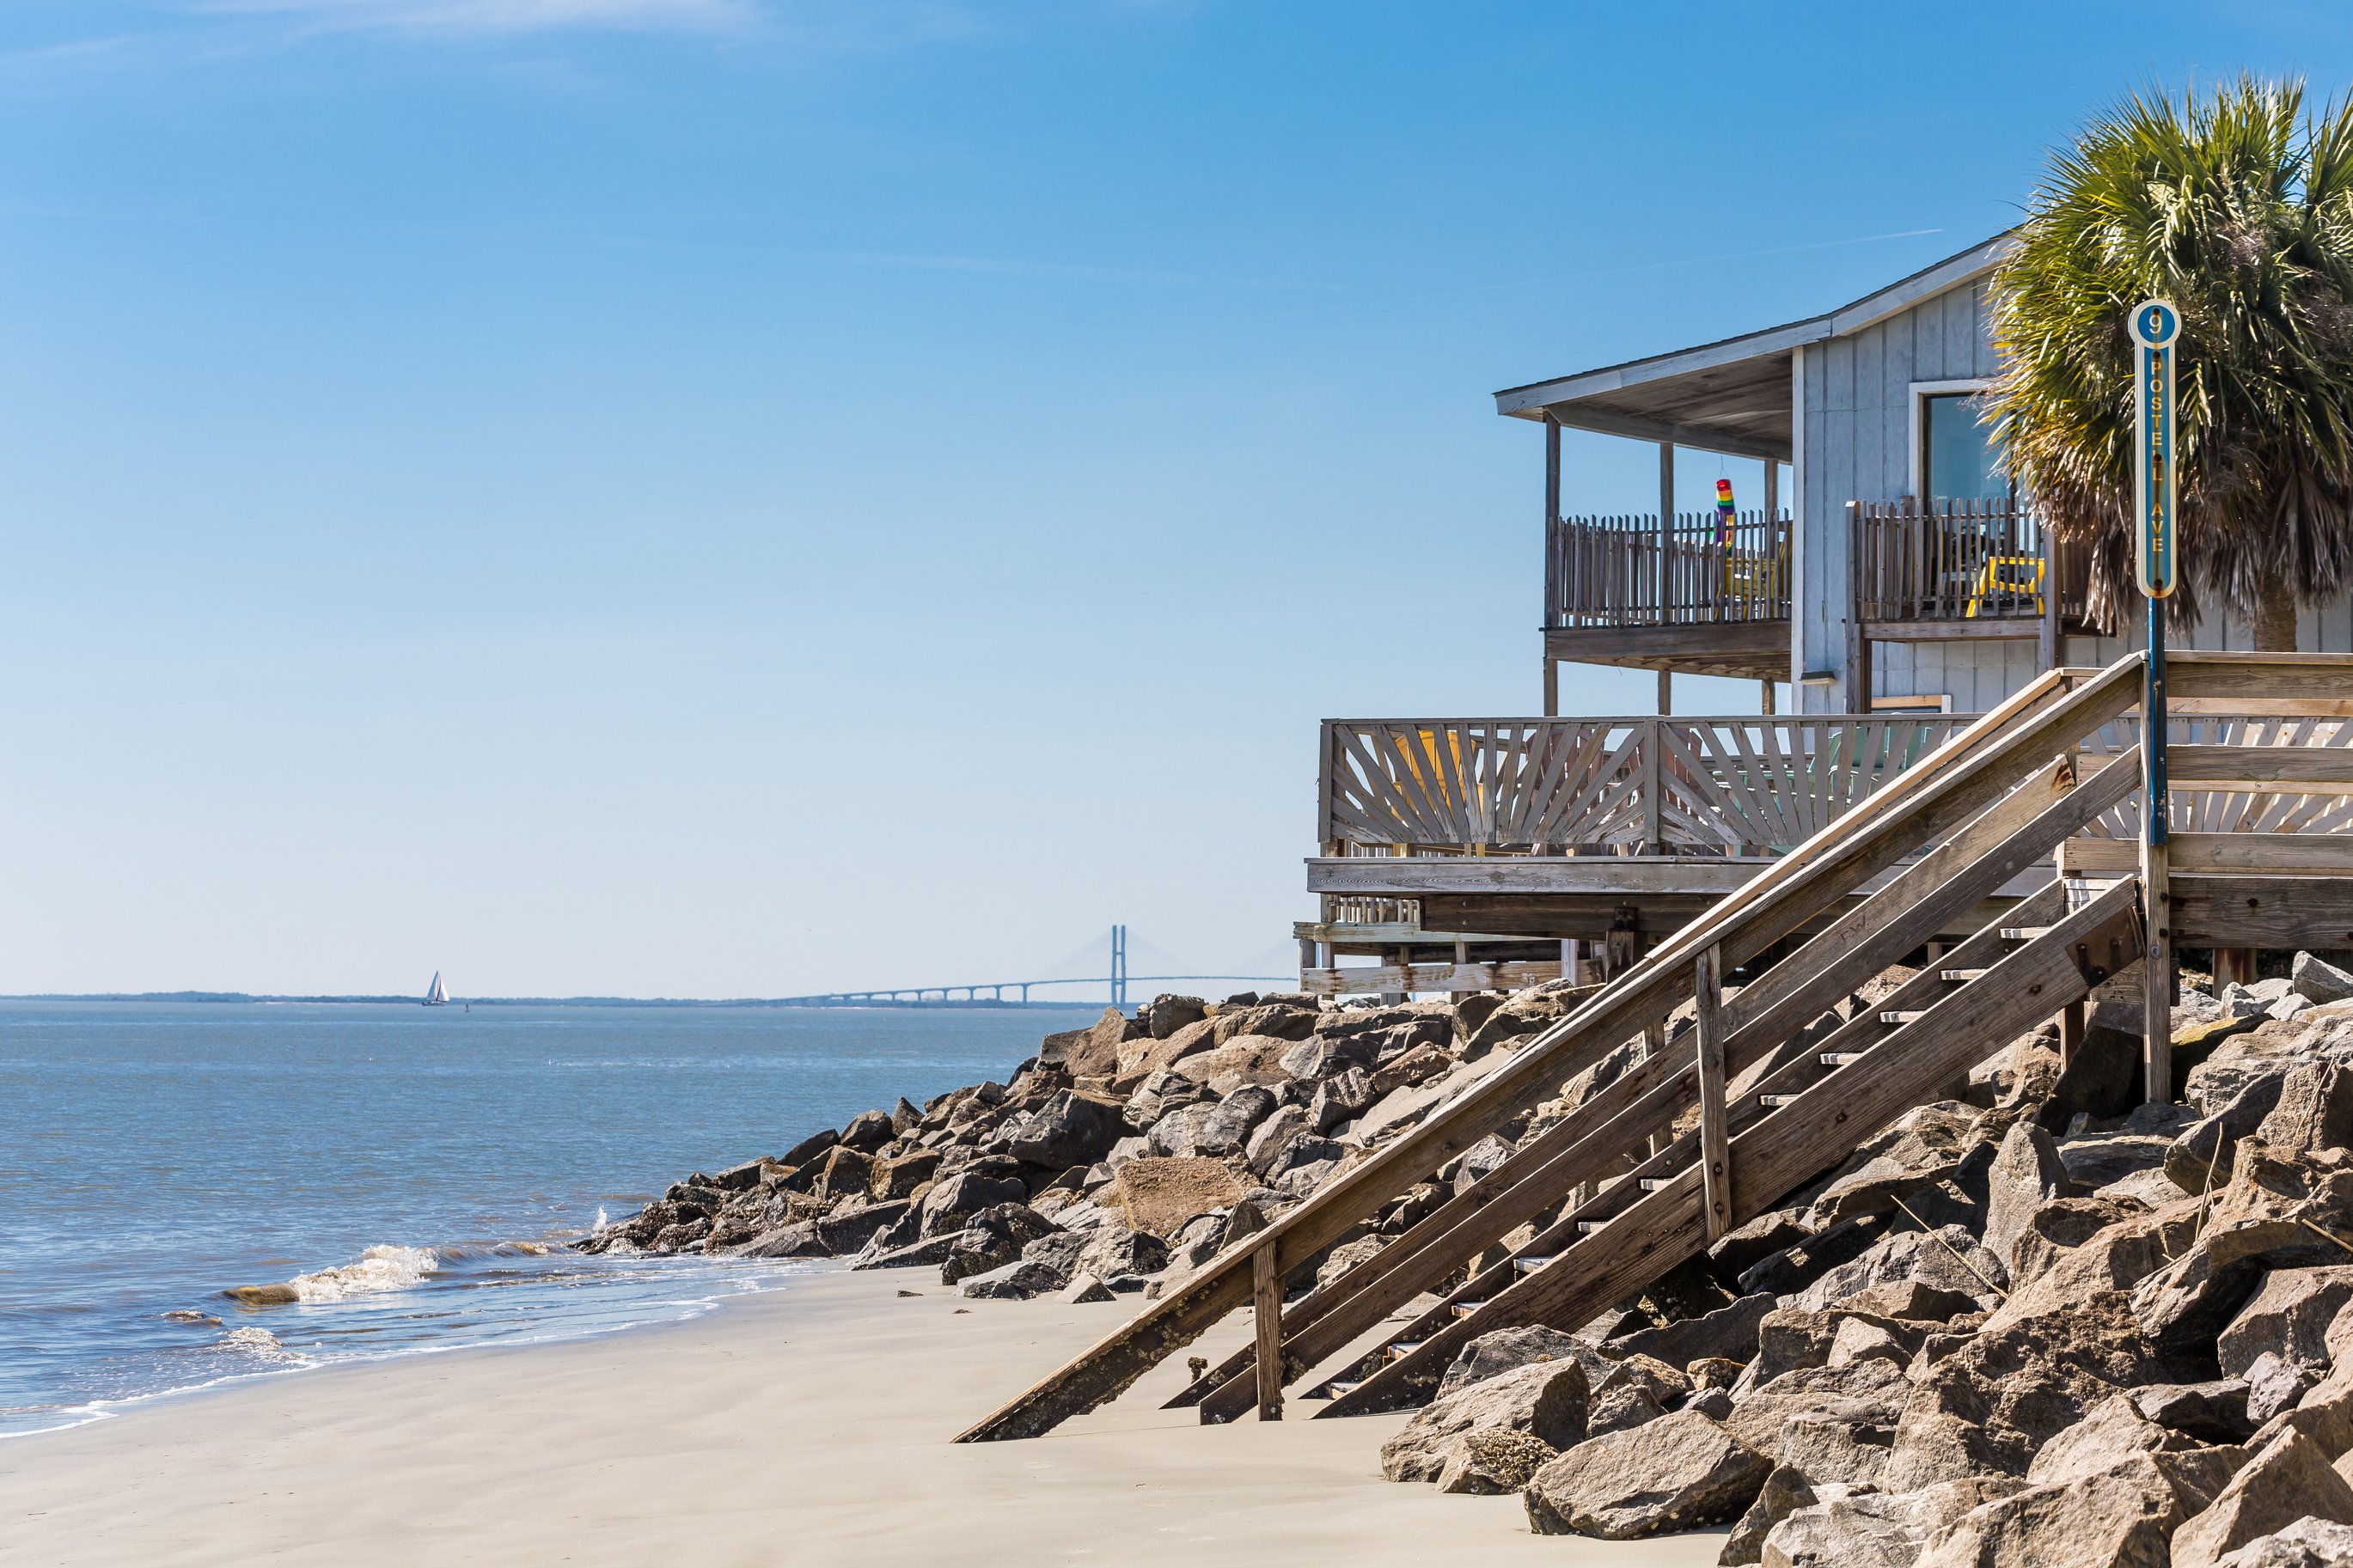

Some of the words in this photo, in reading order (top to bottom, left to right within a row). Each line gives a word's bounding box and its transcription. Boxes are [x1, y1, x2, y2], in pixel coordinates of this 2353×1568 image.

[2148, 314, 2162, 334] 9
[2149, 361, 2163, 481] POSTELL
[2151, 503, 2164, 552] AVE
